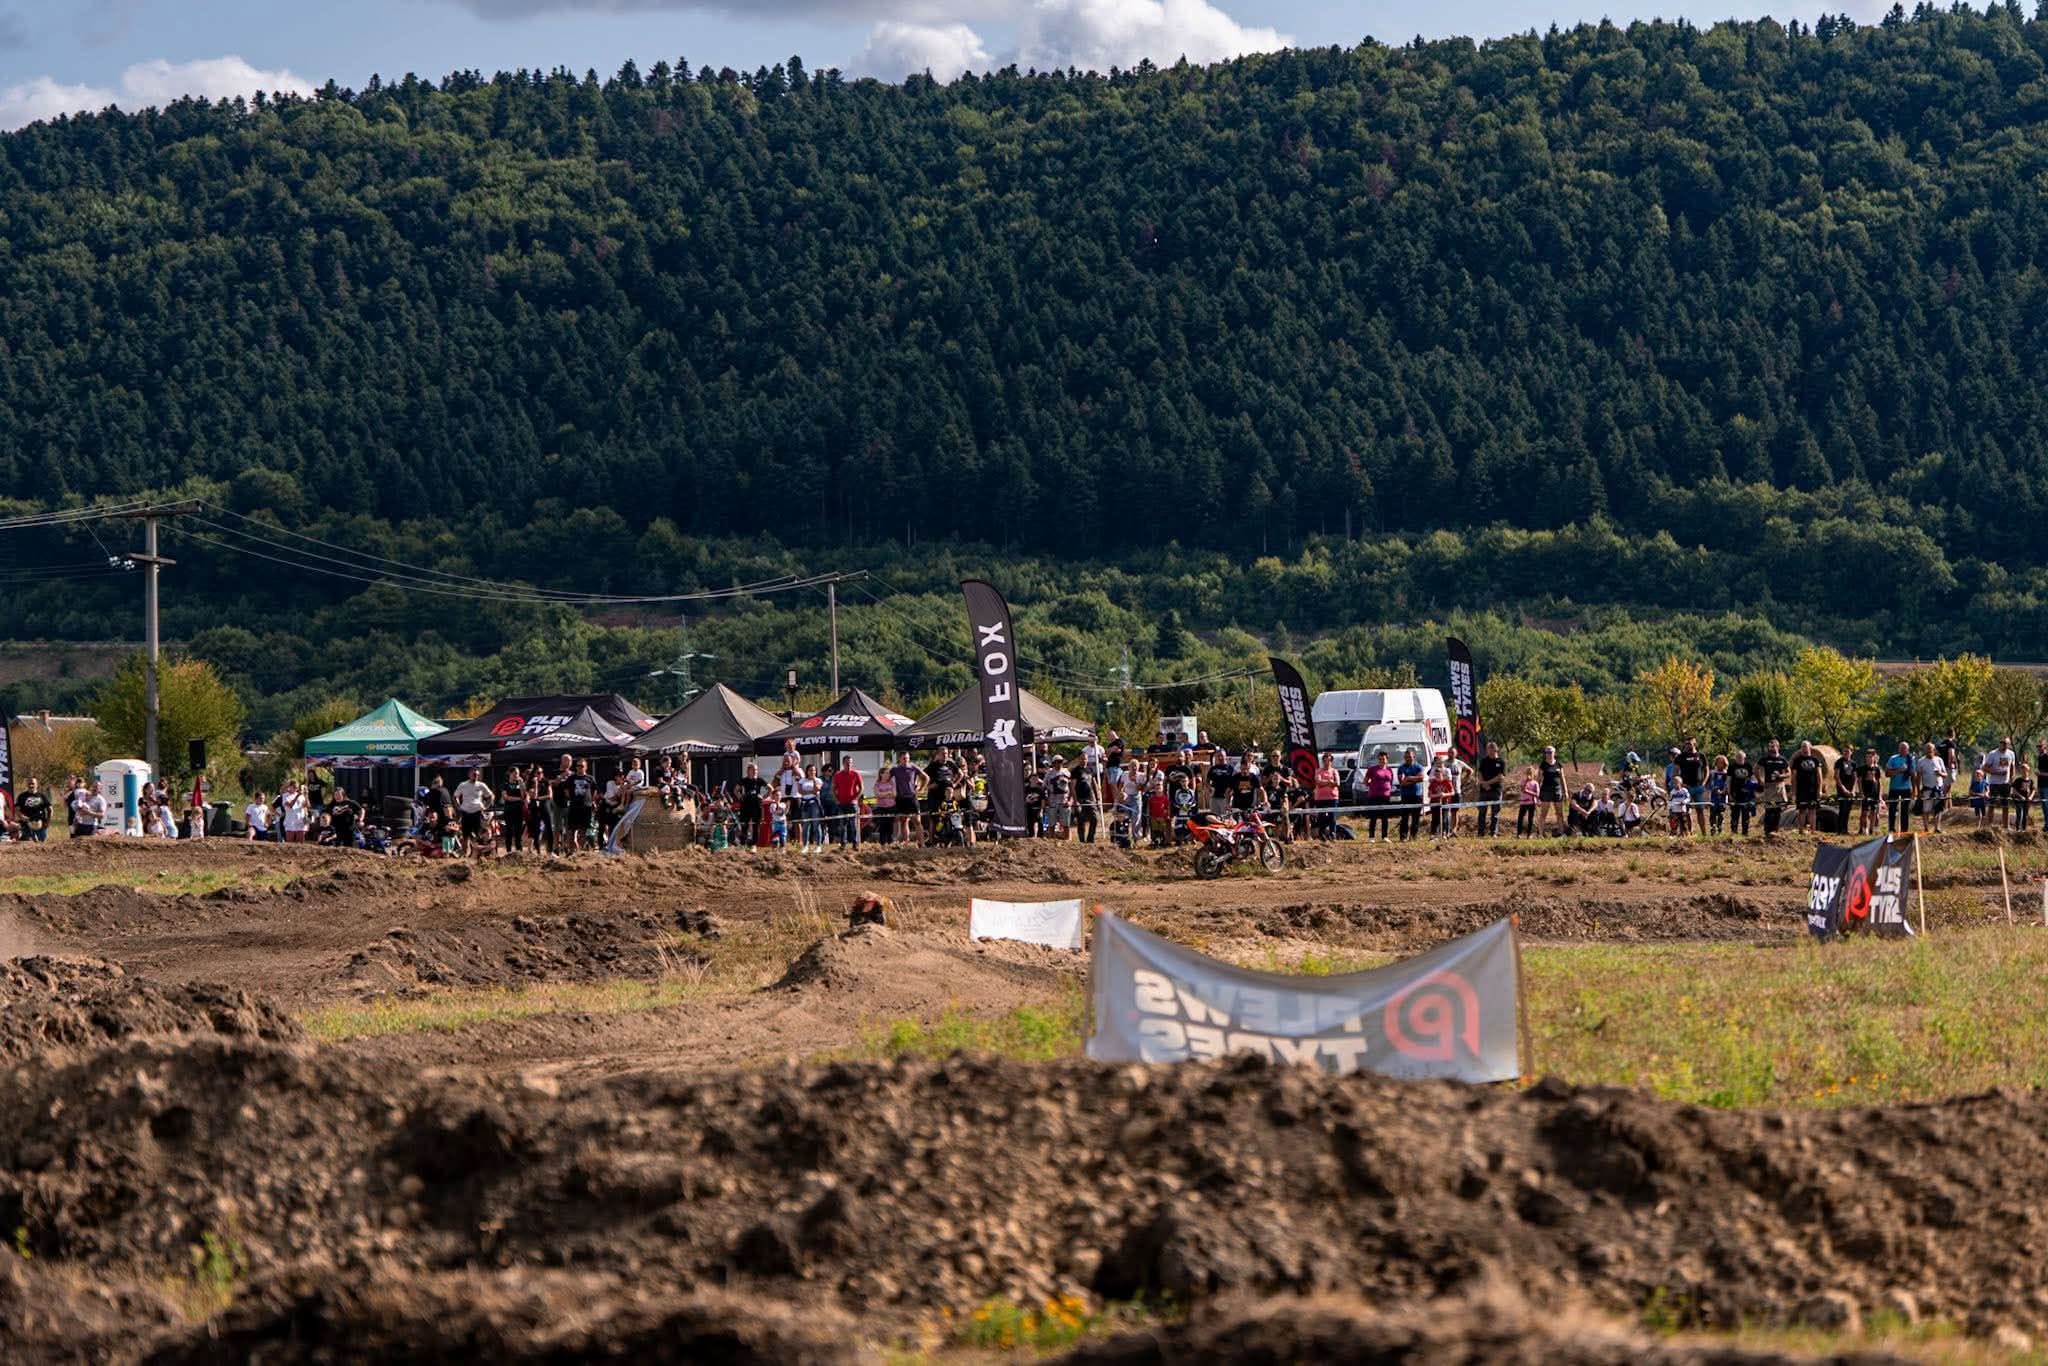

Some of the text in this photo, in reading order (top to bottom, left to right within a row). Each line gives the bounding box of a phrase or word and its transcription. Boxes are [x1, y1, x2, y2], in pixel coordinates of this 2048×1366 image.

[1279, 684, 1300, 744] PLEWS
[1289, 686, 1311, 746] TYRES
[1450, 660, 1463, 716] PLEWS
[1461, 662, 1473, 717] TYRES
[828, 735, 859, 744] TYRES
